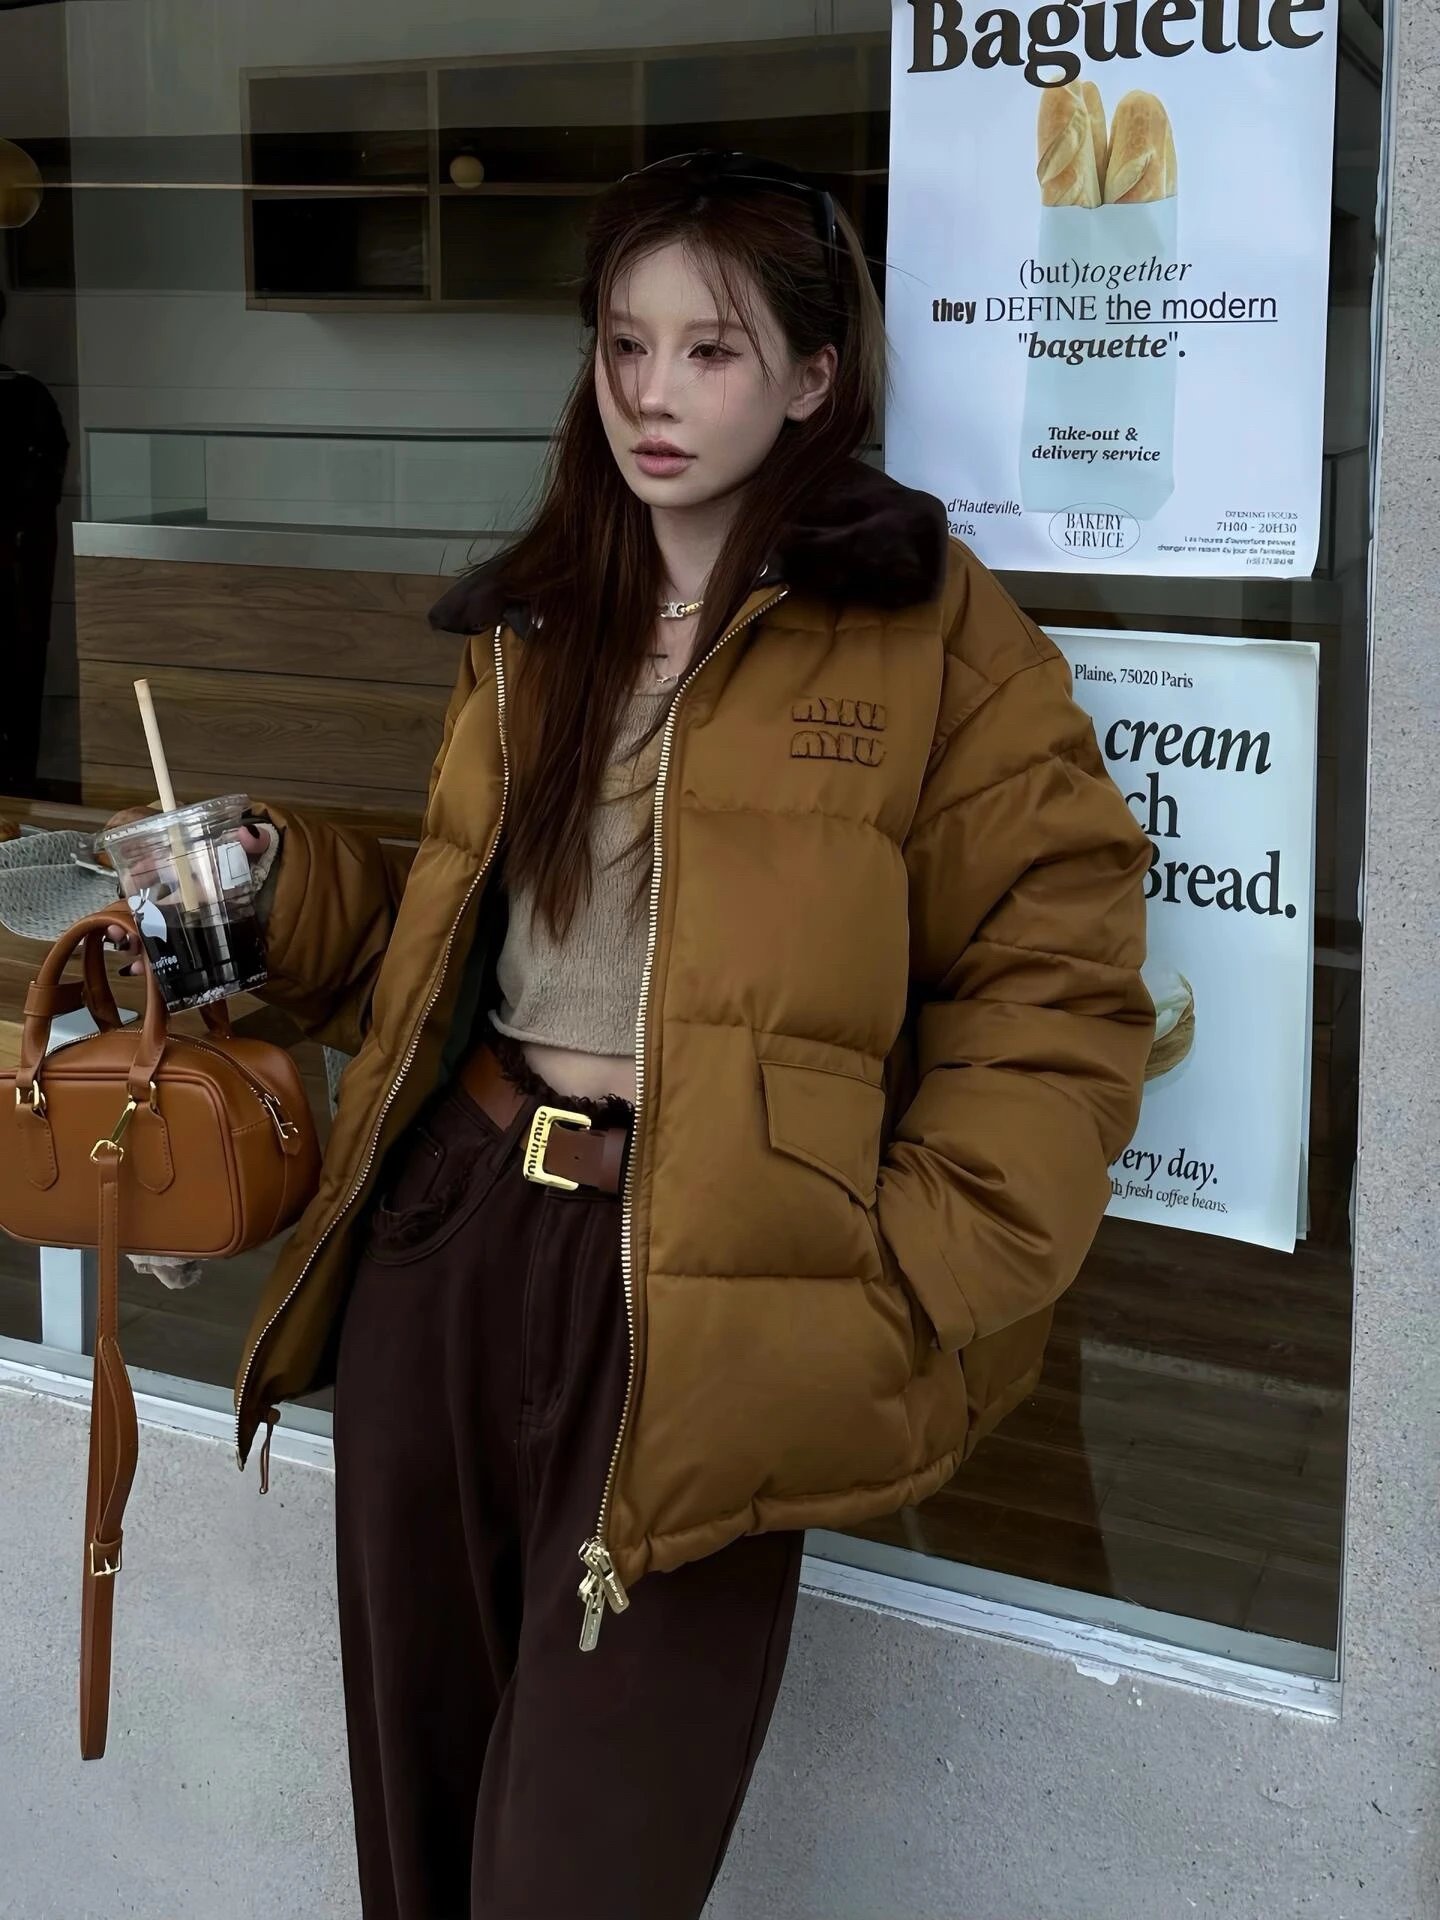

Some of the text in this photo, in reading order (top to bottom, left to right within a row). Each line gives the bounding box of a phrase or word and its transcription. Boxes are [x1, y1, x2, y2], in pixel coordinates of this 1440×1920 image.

[1019, 256, 1193, 289] (but)together
[932, 292, 1278, 324] they DEFINE the modern
[1018, 331, 1186, 365] "baguette".
[1048, 426, 1138, 441] Take-out &
[1031, 445, 1160, 463] delivery service
[1066, 512, 1124, 530] BAKERY
[1064, 531, 1125, 548] SERVICE
[1075, 664, 1194, 689] Plaine, 75020 Paris
[1104, 719, 1271, 774] cream
[1167, 1148, 1218, 1191] day.
[1122, 1180, 1153, 1199] fresh
[1156, 1189, 1190, 1208] coffee
